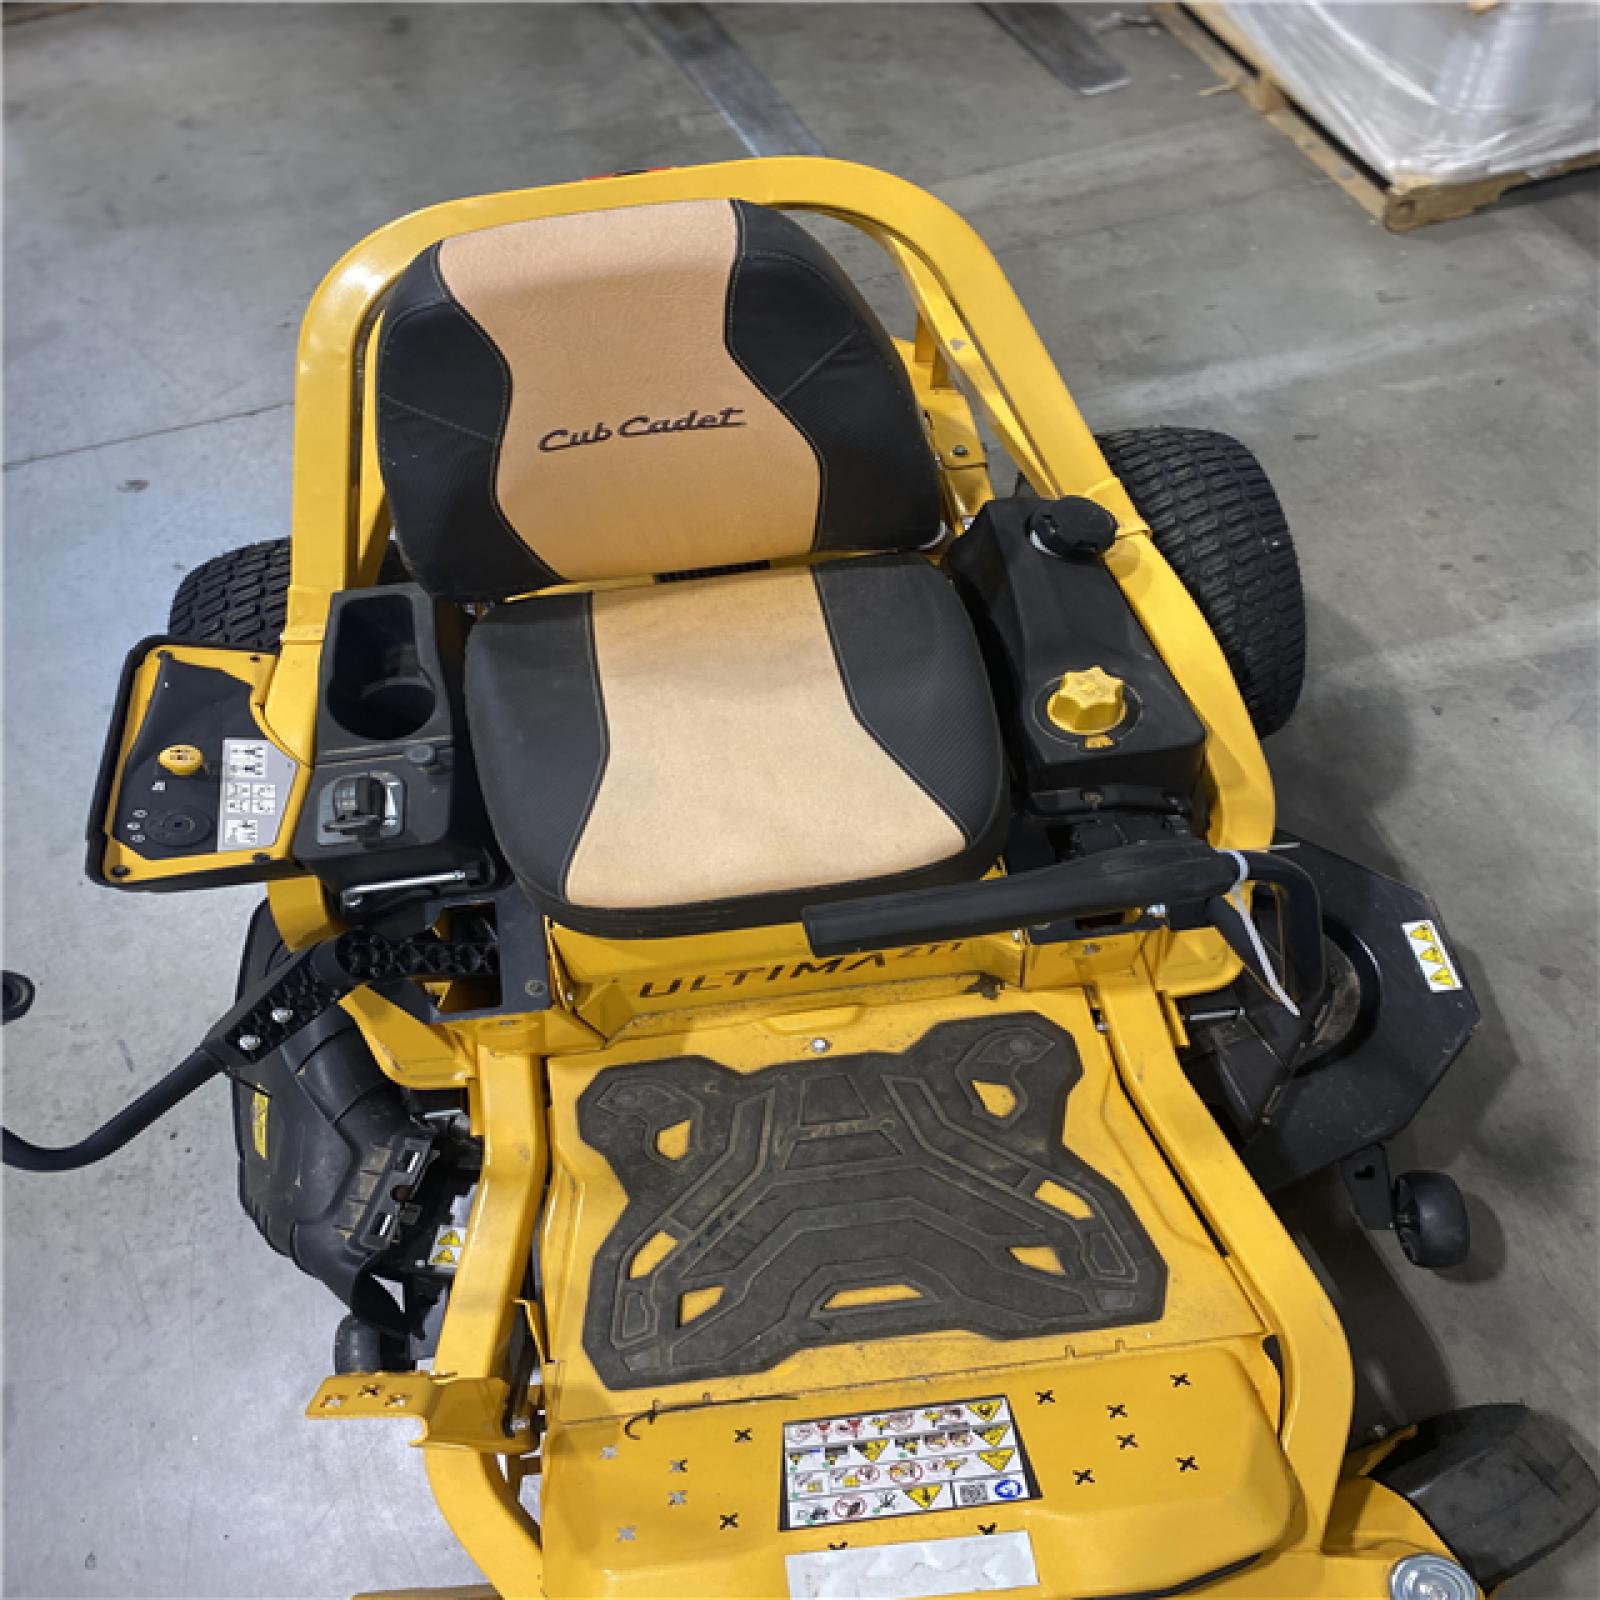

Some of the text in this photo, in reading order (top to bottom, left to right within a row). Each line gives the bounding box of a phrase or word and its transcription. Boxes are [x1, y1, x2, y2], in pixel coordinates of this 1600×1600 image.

[538, 406, 746, 452] Cub Cadet
[639, 952, 886, 998] ULTIMA
